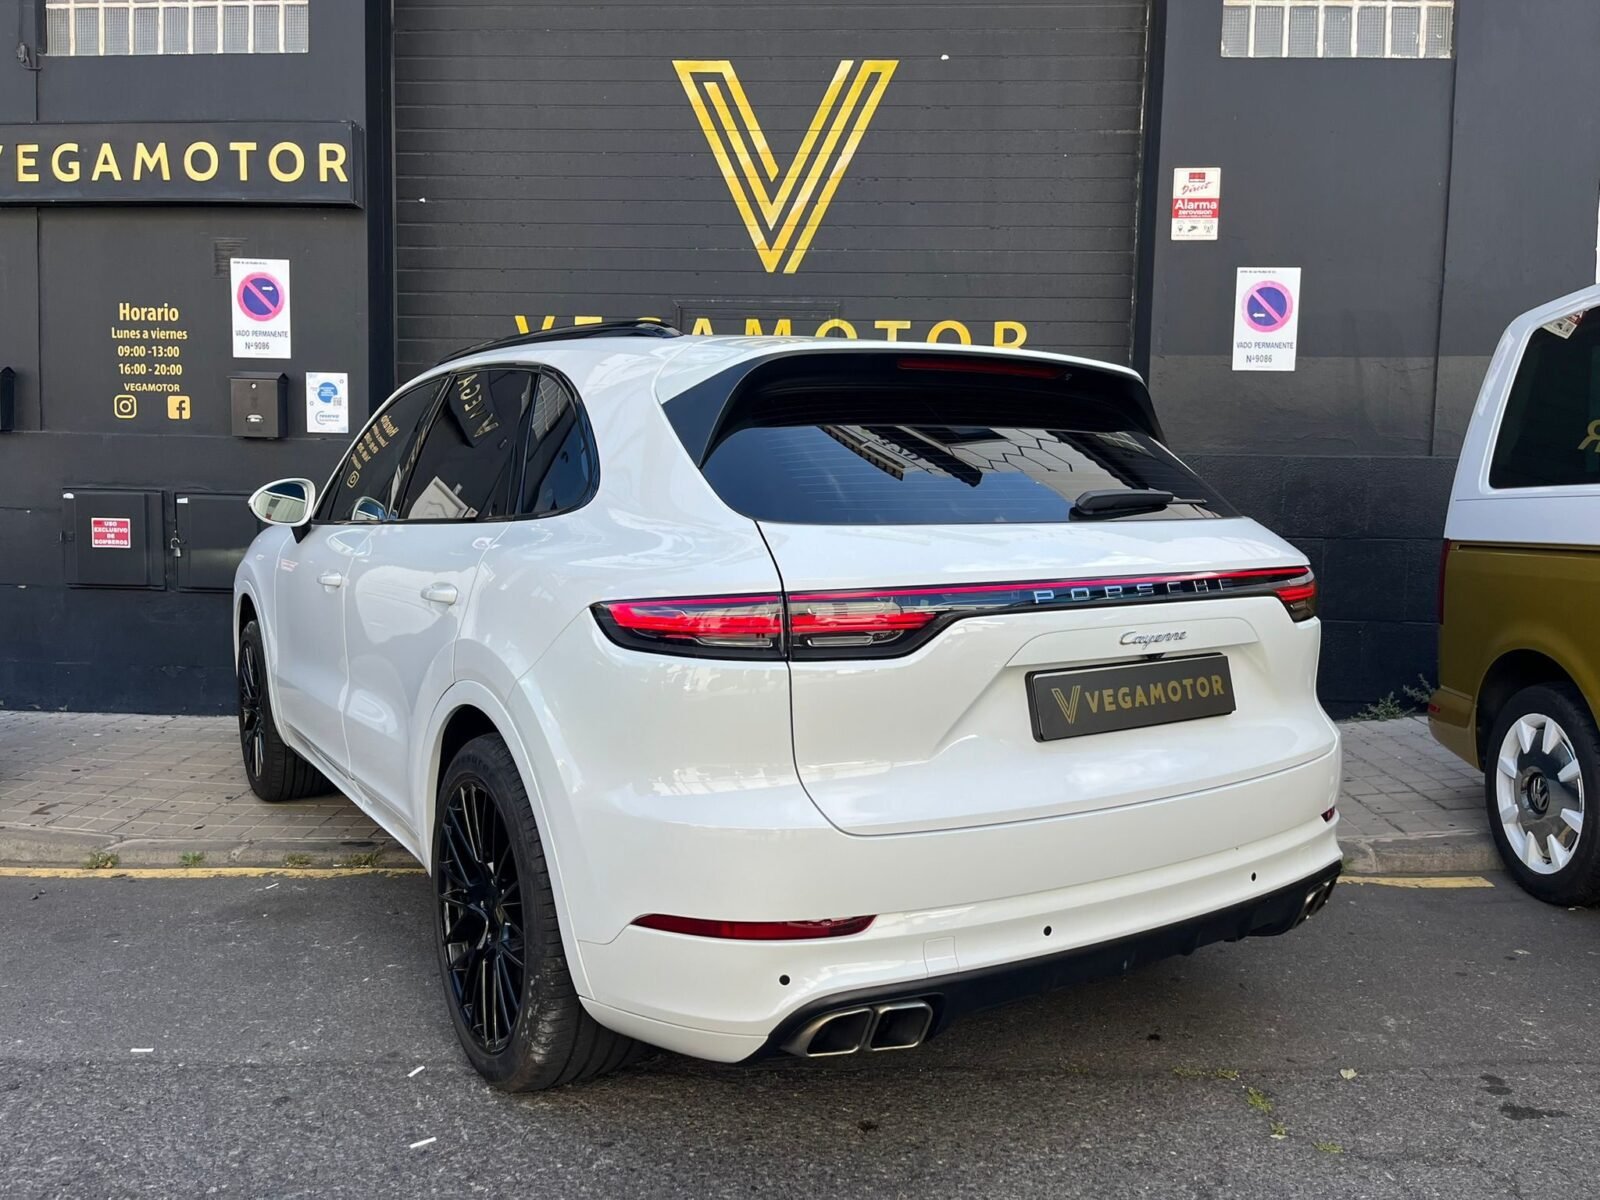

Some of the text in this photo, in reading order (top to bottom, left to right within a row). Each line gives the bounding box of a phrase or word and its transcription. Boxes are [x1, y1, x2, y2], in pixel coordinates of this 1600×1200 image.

[0, 142, 348, 183] EGAMOTOR
[1174, 199, 1217, 210] Alarma
[119, 302, 179, 322] Horario
[111, 327, 188, 340] Lunes a viernes
[252, 330, 288, 338] PERMANENTE
[514, 315, 1028, 349] VAMOTOR
[117, 345, 146, 357] 09:00
[118, 363, 147, 375] 16:00
[154, 364, 183, 376] 20:00
[123, 383, 181, 392] VEGAMOTOR
[1033, 578, 1233, 604] PORSCHE
[1119, 630, 1187, 648] Cayenne
[1085, 674, 1225, 714] VEGAMOTOR
